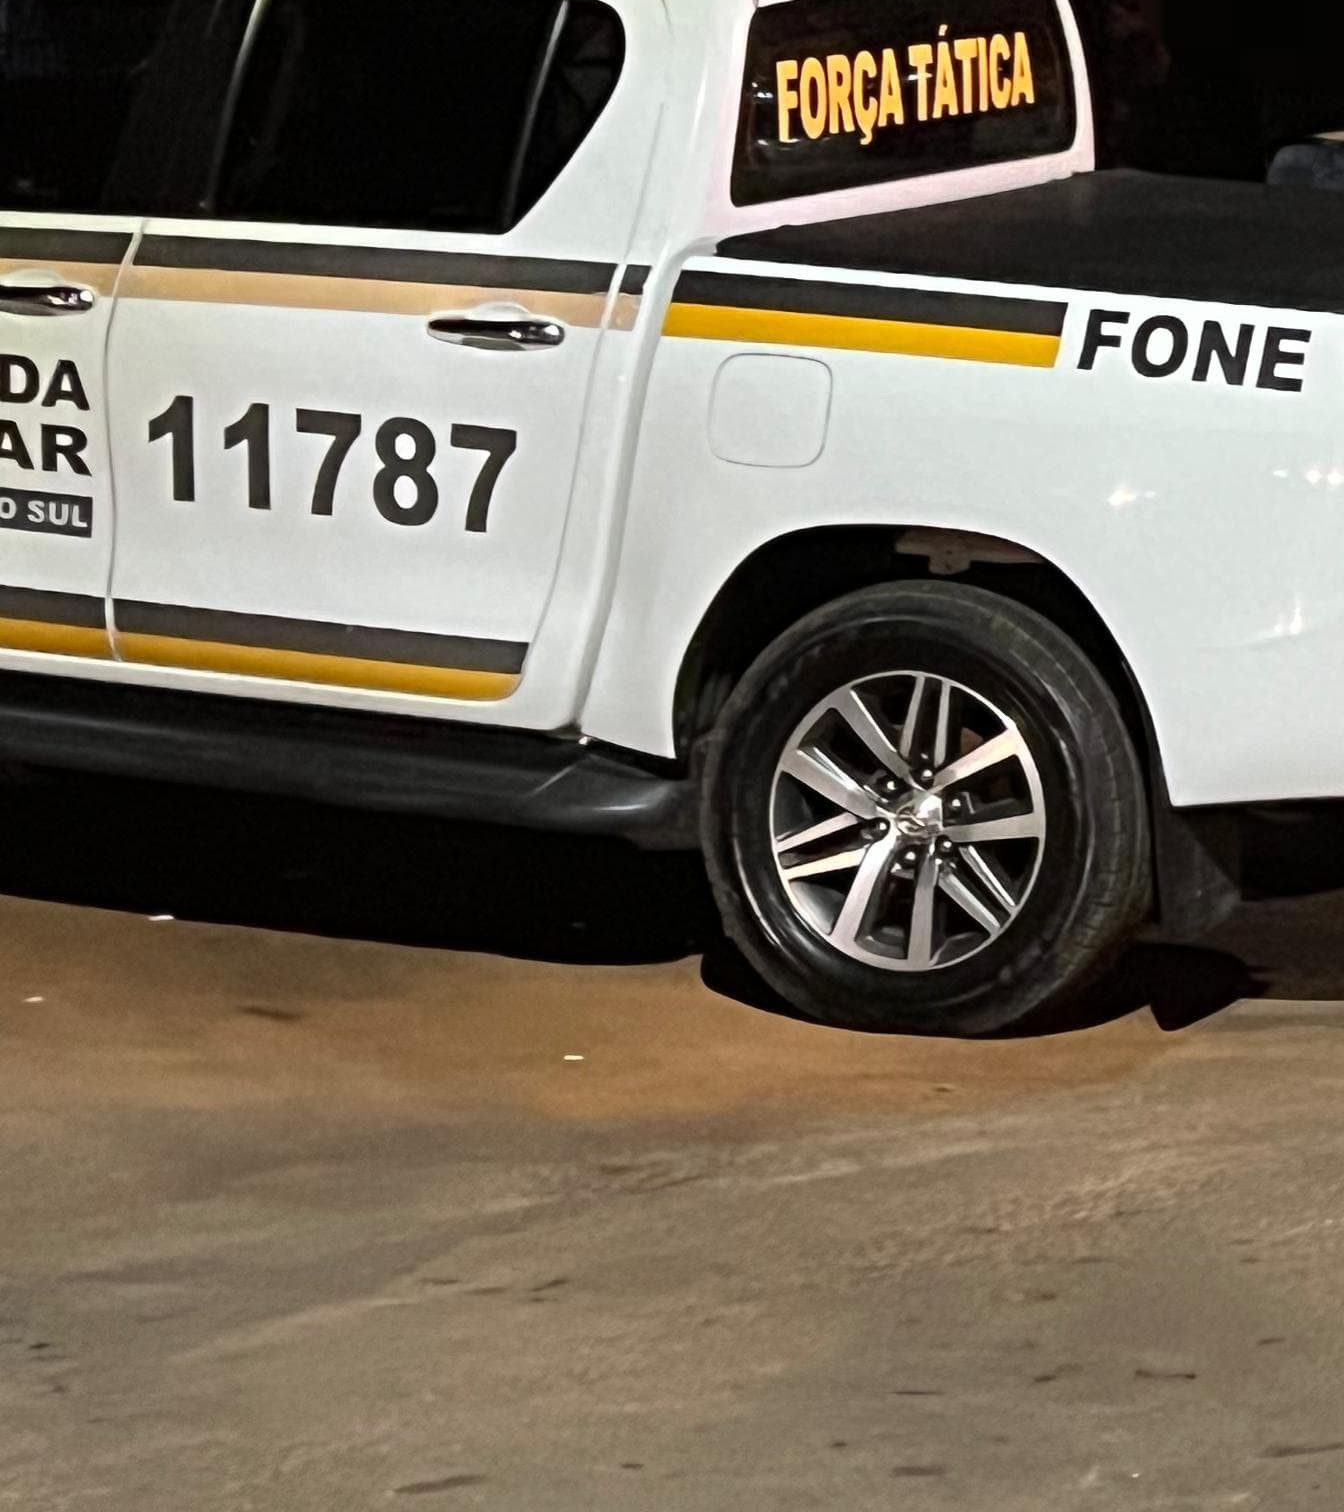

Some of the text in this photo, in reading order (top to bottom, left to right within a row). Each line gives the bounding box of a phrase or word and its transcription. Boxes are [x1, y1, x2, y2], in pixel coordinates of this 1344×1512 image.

[776, 24, 1034, 145] FORÇA TÁTICA
[1077, 309, 1312, 392] FONE
[27, 500, 88, 528] SUL
[148, 395, 517, 533] 11787
